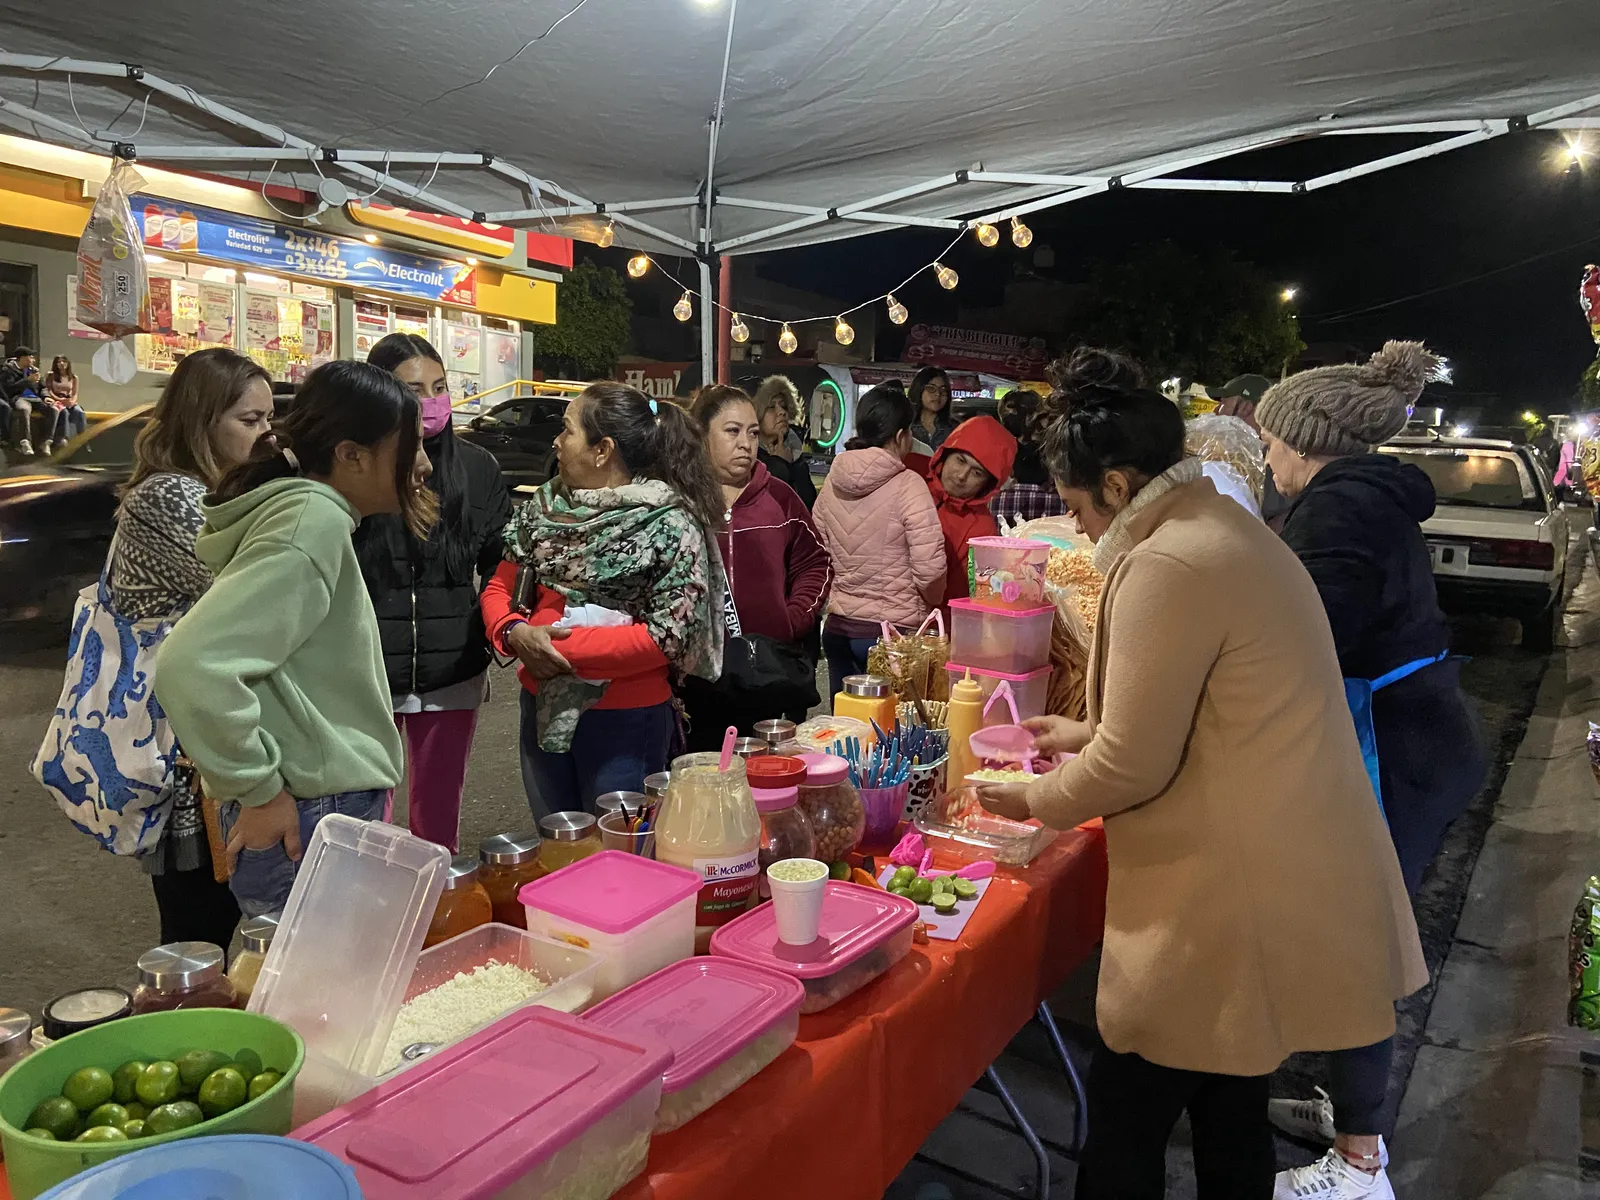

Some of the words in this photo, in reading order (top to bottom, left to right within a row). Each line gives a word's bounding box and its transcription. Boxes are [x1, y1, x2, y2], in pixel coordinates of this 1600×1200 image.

[225, 240, 251, 251] Variedad
[252, 245, 263, 253] 625
[117, 275, 126, 292] 250
[388, 263, 445, 287] Electrolit
[720, 858, 757, 876] McCORMICK
[713, 882, 754, 898] Mayonesa
